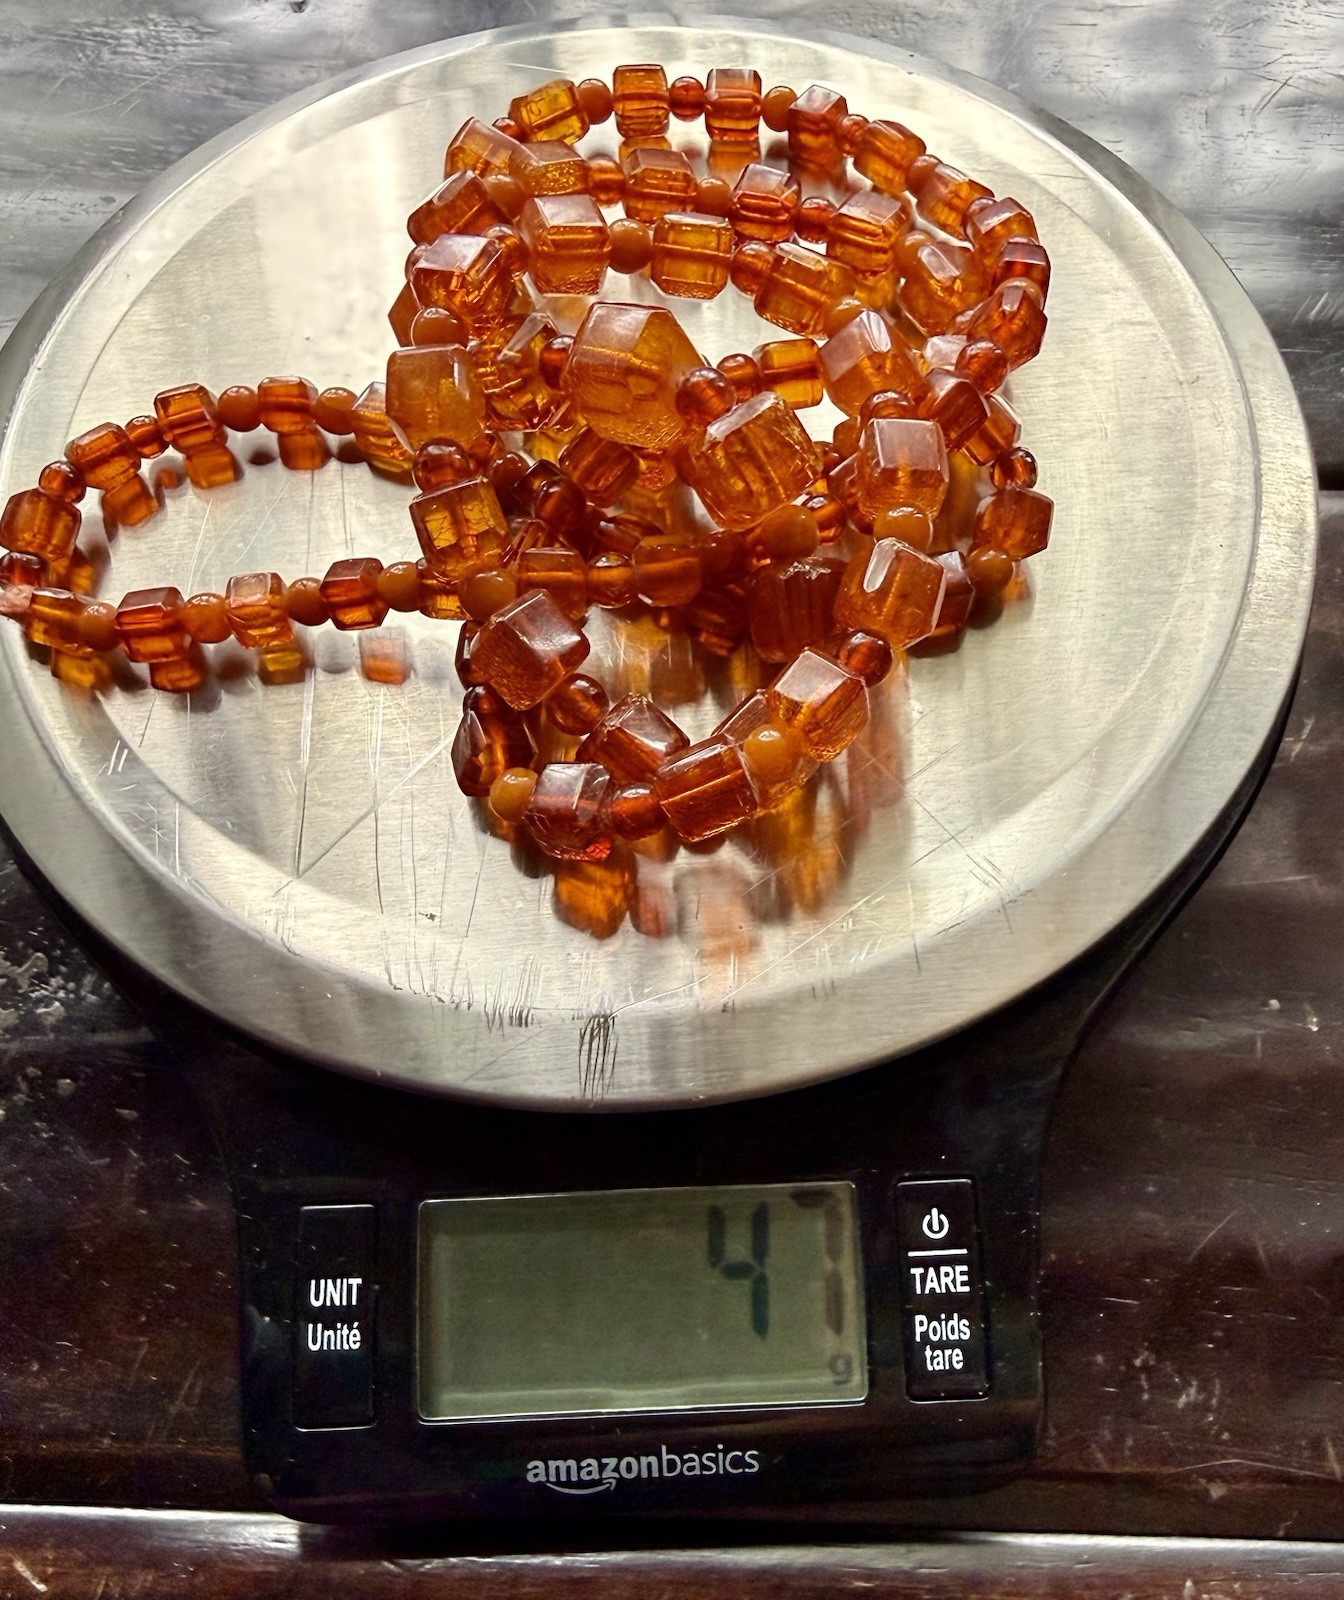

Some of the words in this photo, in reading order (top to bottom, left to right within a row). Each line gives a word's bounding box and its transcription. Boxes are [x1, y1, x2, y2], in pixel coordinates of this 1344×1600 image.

[707, 1188, 845, 1340] 47
[310, 1278, 362, 1307] UNIT
[910, 1265, 970, 1294] TARE
[307, 1322, 361, 1351] Unité
[914, 1313, 970, 1342] Poids
[828, 1353, 853, 1386] g
[925, 1345, 964, 1371] tare
[526, 1444, 760, 1485] amazonbasics
